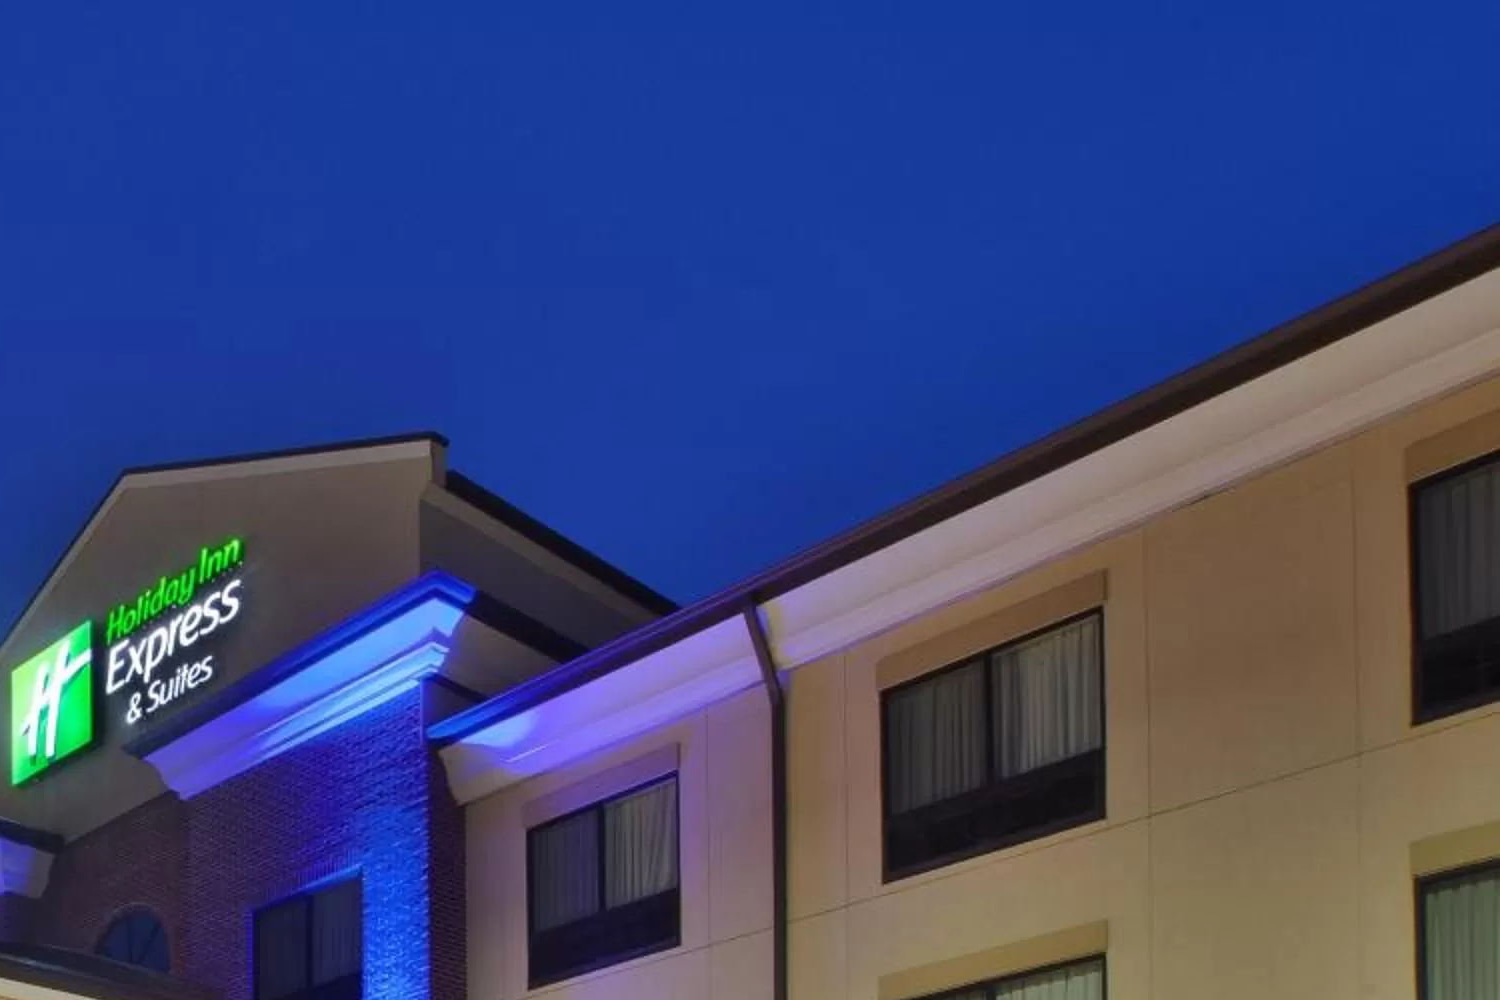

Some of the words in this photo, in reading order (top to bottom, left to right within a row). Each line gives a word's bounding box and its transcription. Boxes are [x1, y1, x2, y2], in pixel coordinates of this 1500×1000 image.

[106, 574, 196, 645] Holiday
[199, 538, 242, 583] Inn
[106, 579, 241, 694] Express
[125, 692, 142, 725] &
[146, 655, 214, 714] Suites
